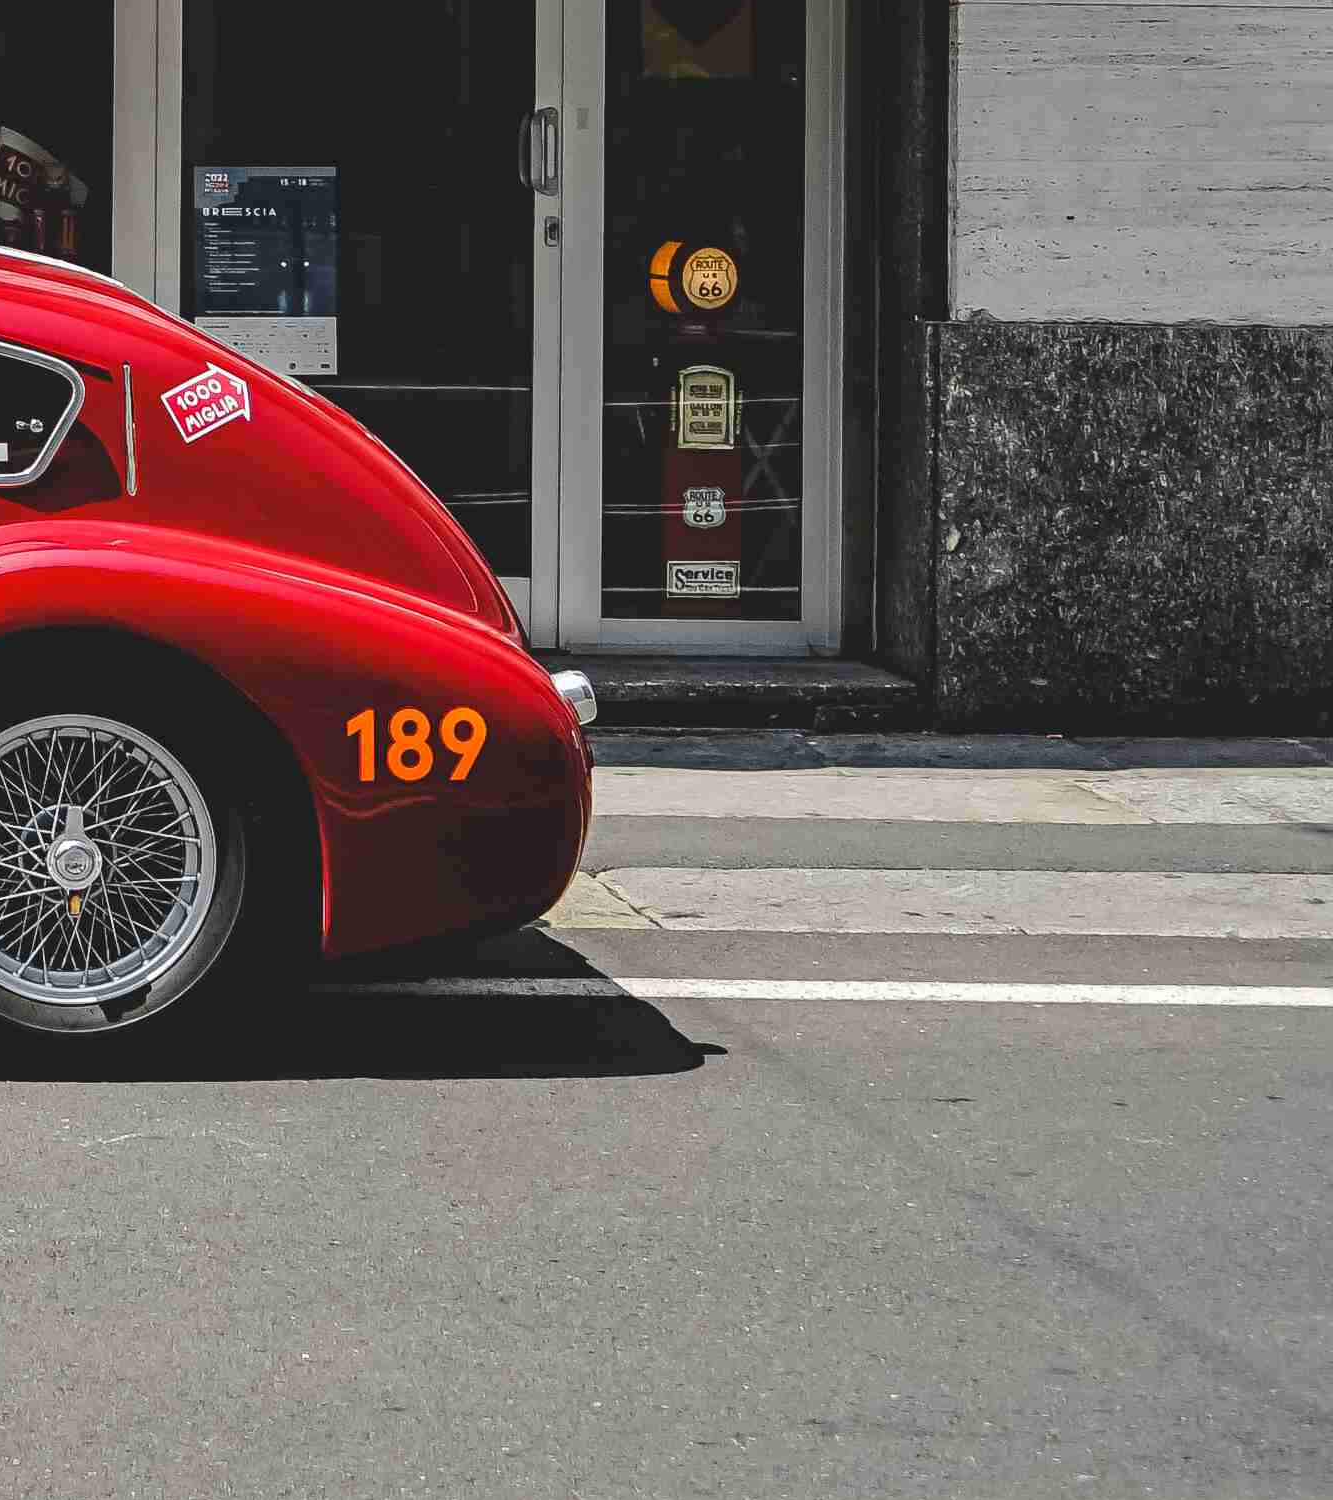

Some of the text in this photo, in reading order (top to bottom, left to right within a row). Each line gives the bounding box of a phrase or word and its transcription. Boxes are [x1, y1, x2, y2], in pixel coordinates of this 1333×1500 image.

[202, 207, 277, 217] BRESCIA
[695, 260, 724, 269] ROUTE
[699, 280, 723, 297] 66
[177, 379, 222, 411] 1000
[185, 395, 239, 433] MIGLIA
[693, 510, 714, 523] 66
[675, 567, 734, 591] Service
[346, 707, 487, 781] 189
